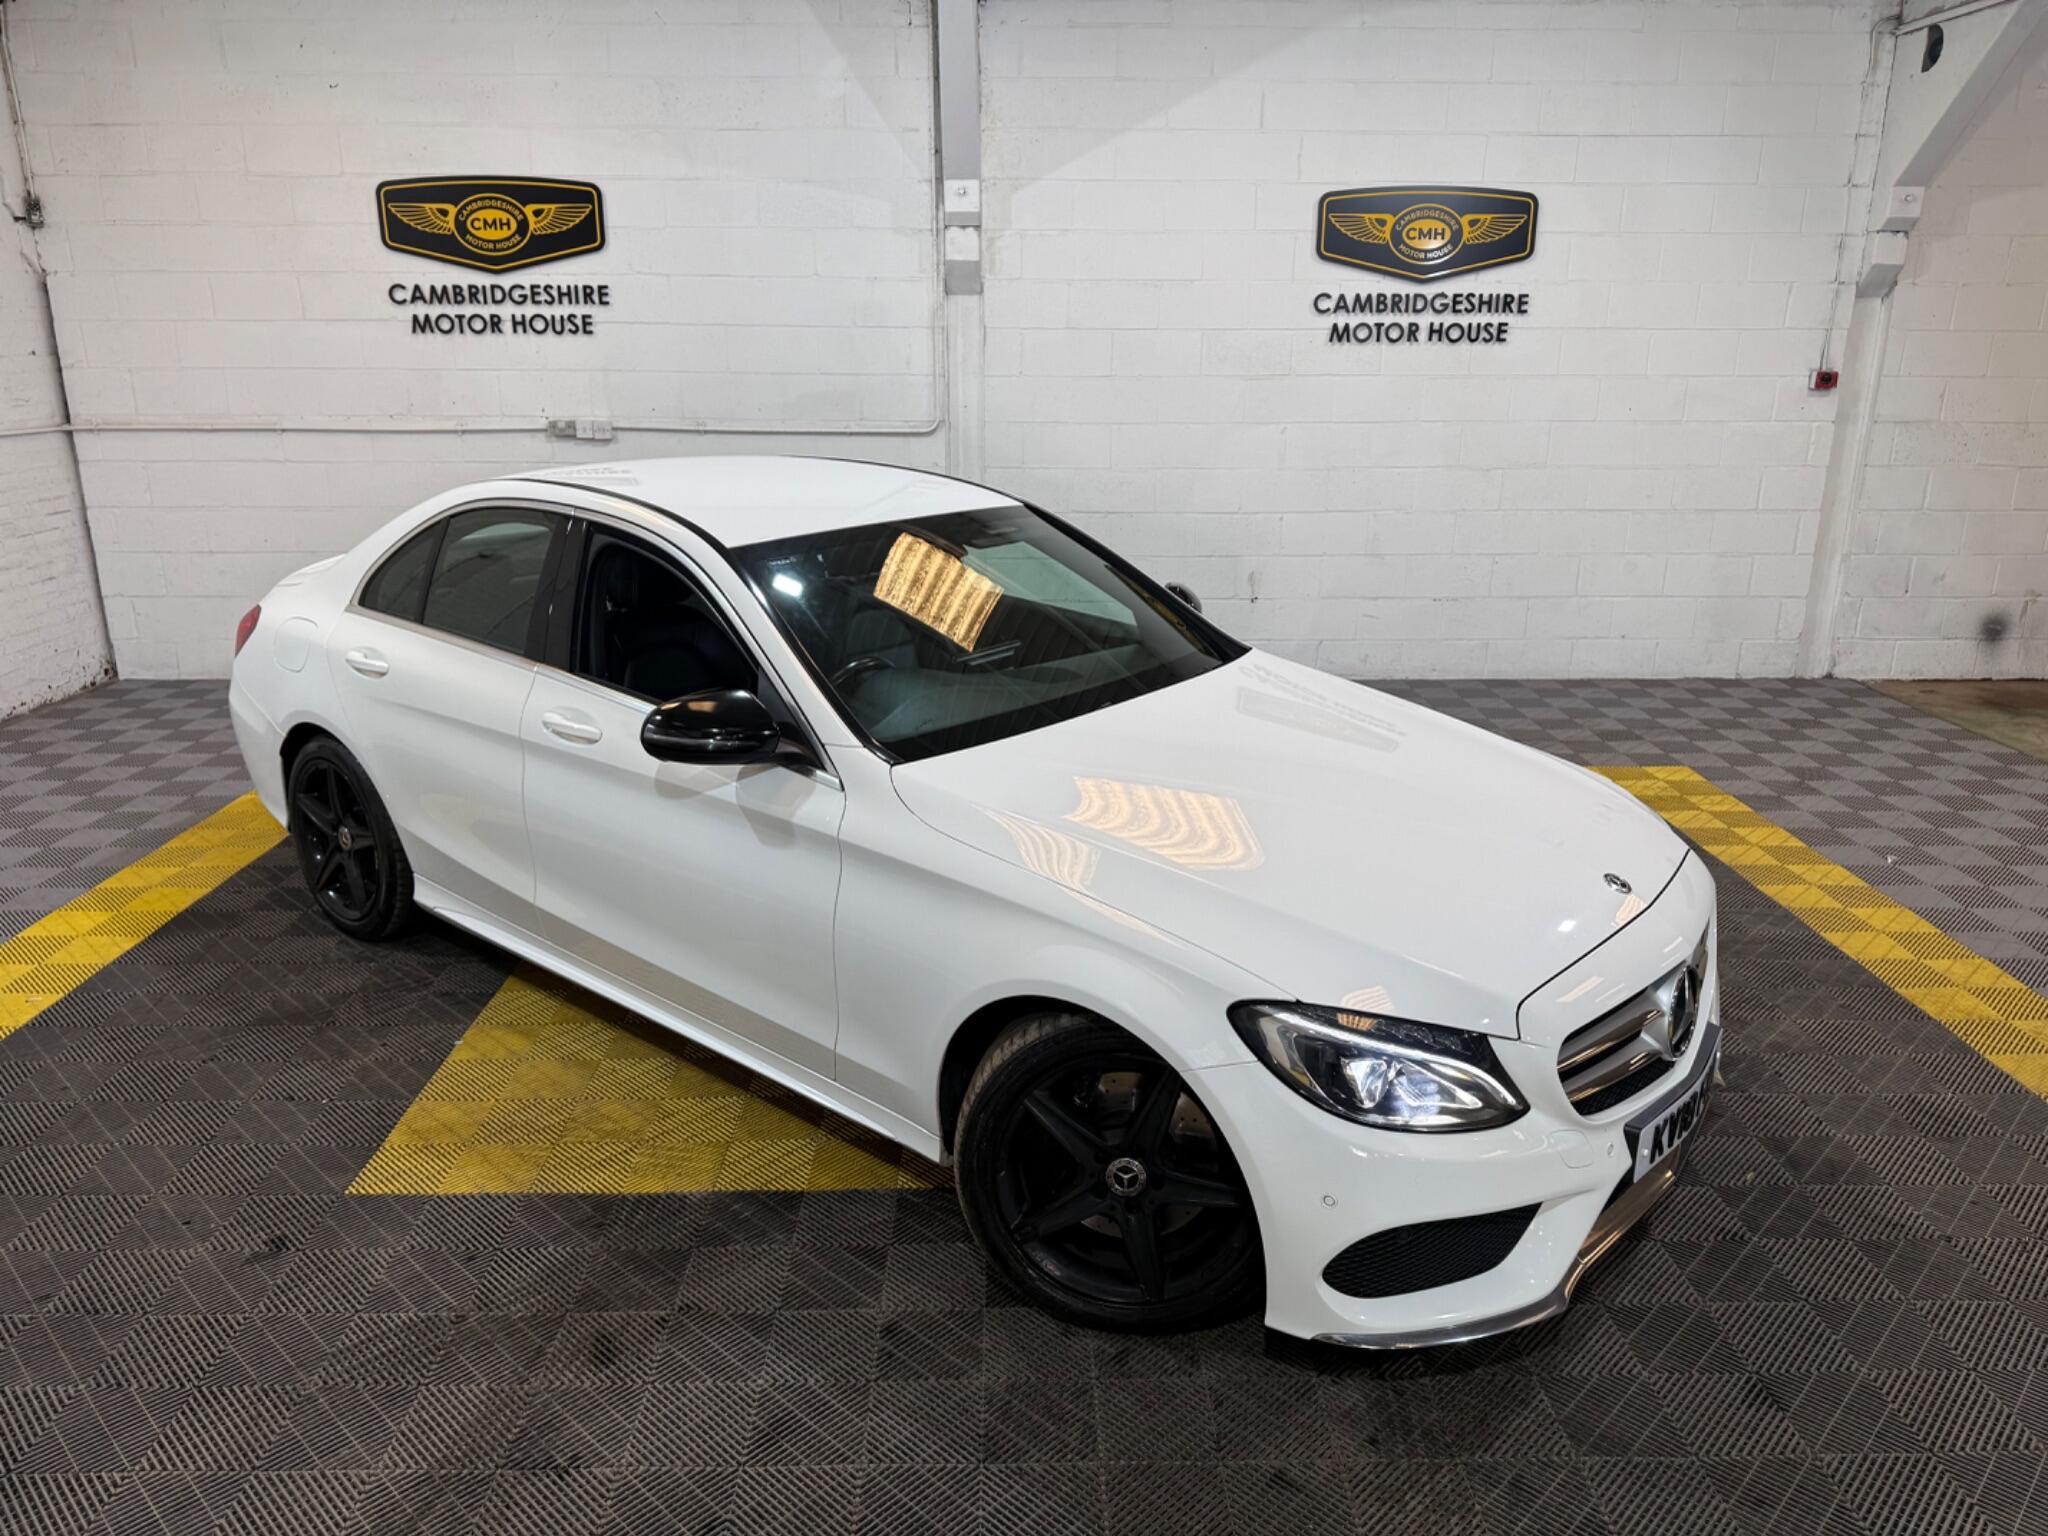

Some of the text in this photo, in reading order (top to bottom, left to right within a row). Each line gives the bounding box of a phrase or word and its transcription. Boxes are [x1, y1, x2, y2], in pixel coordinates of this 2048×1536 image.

[459, 200, 524, 221] CAMBRIDGESHIRE
[1395, 209, 1459, 231] CAMBRIDGESHIRE
[470, 217, 511, 231] CMH
[1406, 227, 1446, 240] CMH
[465, 234, 522, 249] MOTOR HOUSE
[1399, 243, 1454, 259] MOTOR HOUSE
[388, 283, 610, 306] CAMBRIDGESHIRE
[1313, 292, 1529, 315] CAMBRIDGESHIRE
[411, 313, 594, 336] MOTOR HOUSE
[1328, 322, 1509, 344] MOTOR HOUSE
